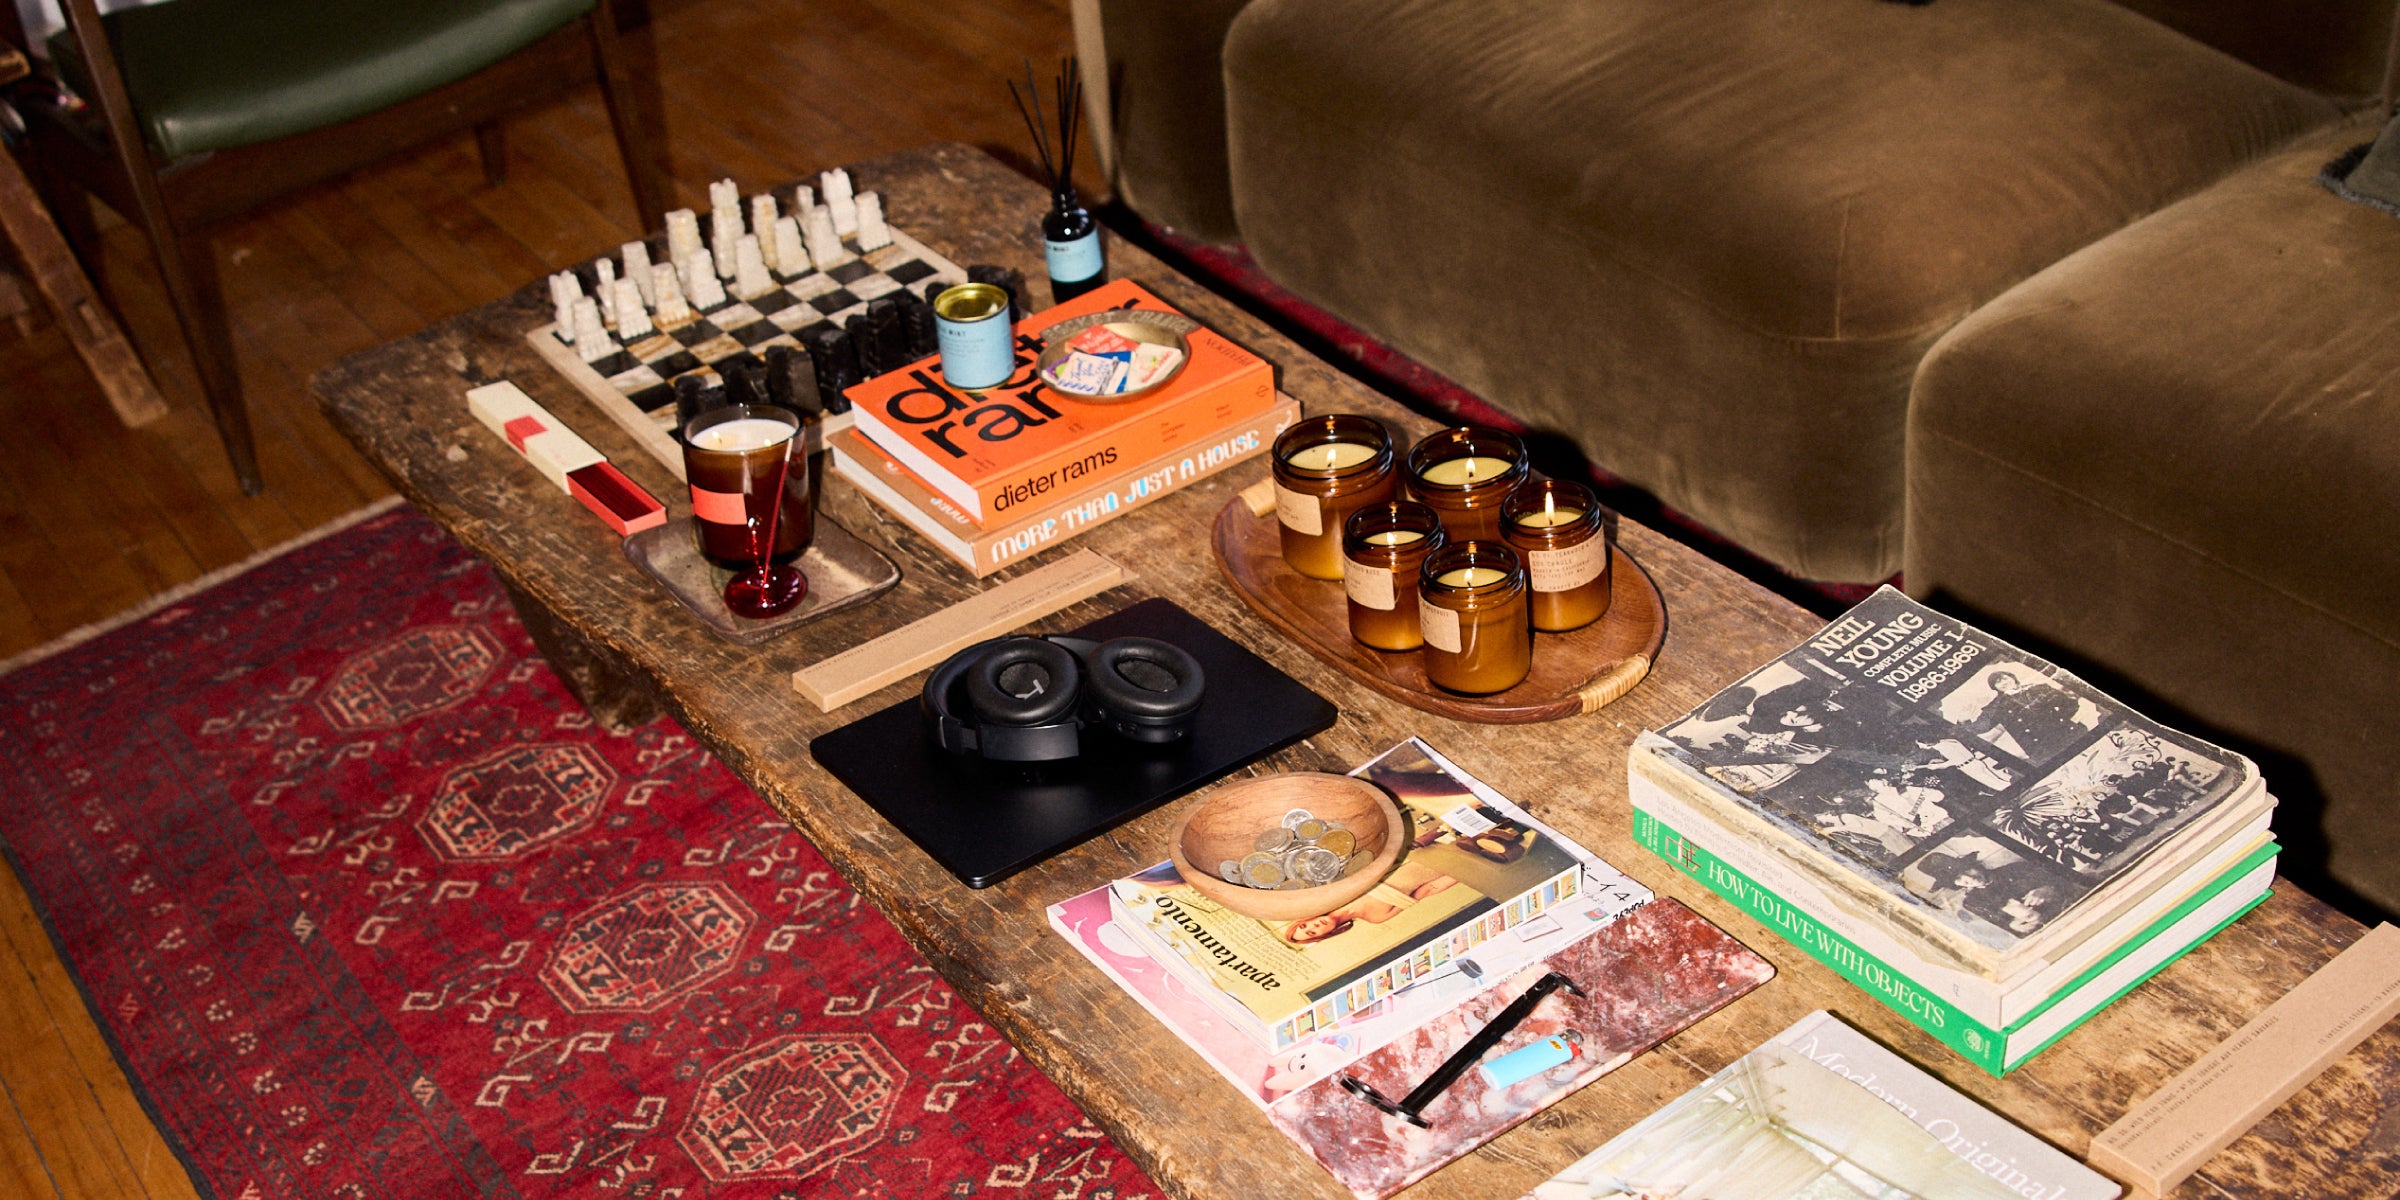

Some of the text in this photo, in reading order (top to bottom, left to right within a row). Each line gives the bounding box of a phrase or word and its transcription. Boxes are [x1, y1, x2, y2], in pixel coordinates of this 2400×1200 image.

[991, 518, 1059, 565] MORE
[1061, 492, 1119, 530] THAN
[1125, 466, 1176, 504] JUST
[1180, 458, 1196, 481] A
[1198, 429, 1261, 471] HOUSE
[994, 470, 1058, 513] dieter
[1062, 446, 1118, 483] rams
[1809, 615, 1876, 657] NEIL
[1835, 611, 1924, 669] YOUNG
[1864, 623, 1942, 677] COMPLETE MUSIC
[1877, 639, 1952, 688] VOLUME
[1897, 639, 1987, 703] [1966-1969]
[1613, 899, 1645, 921] POPEYE
[1156, 896, 1281, 991] apartamento
[1709, 860, 1945, 1028] HOW TO LIVE WITH OBJECTS
[1799, 1036, 1917, 1118] Modern
